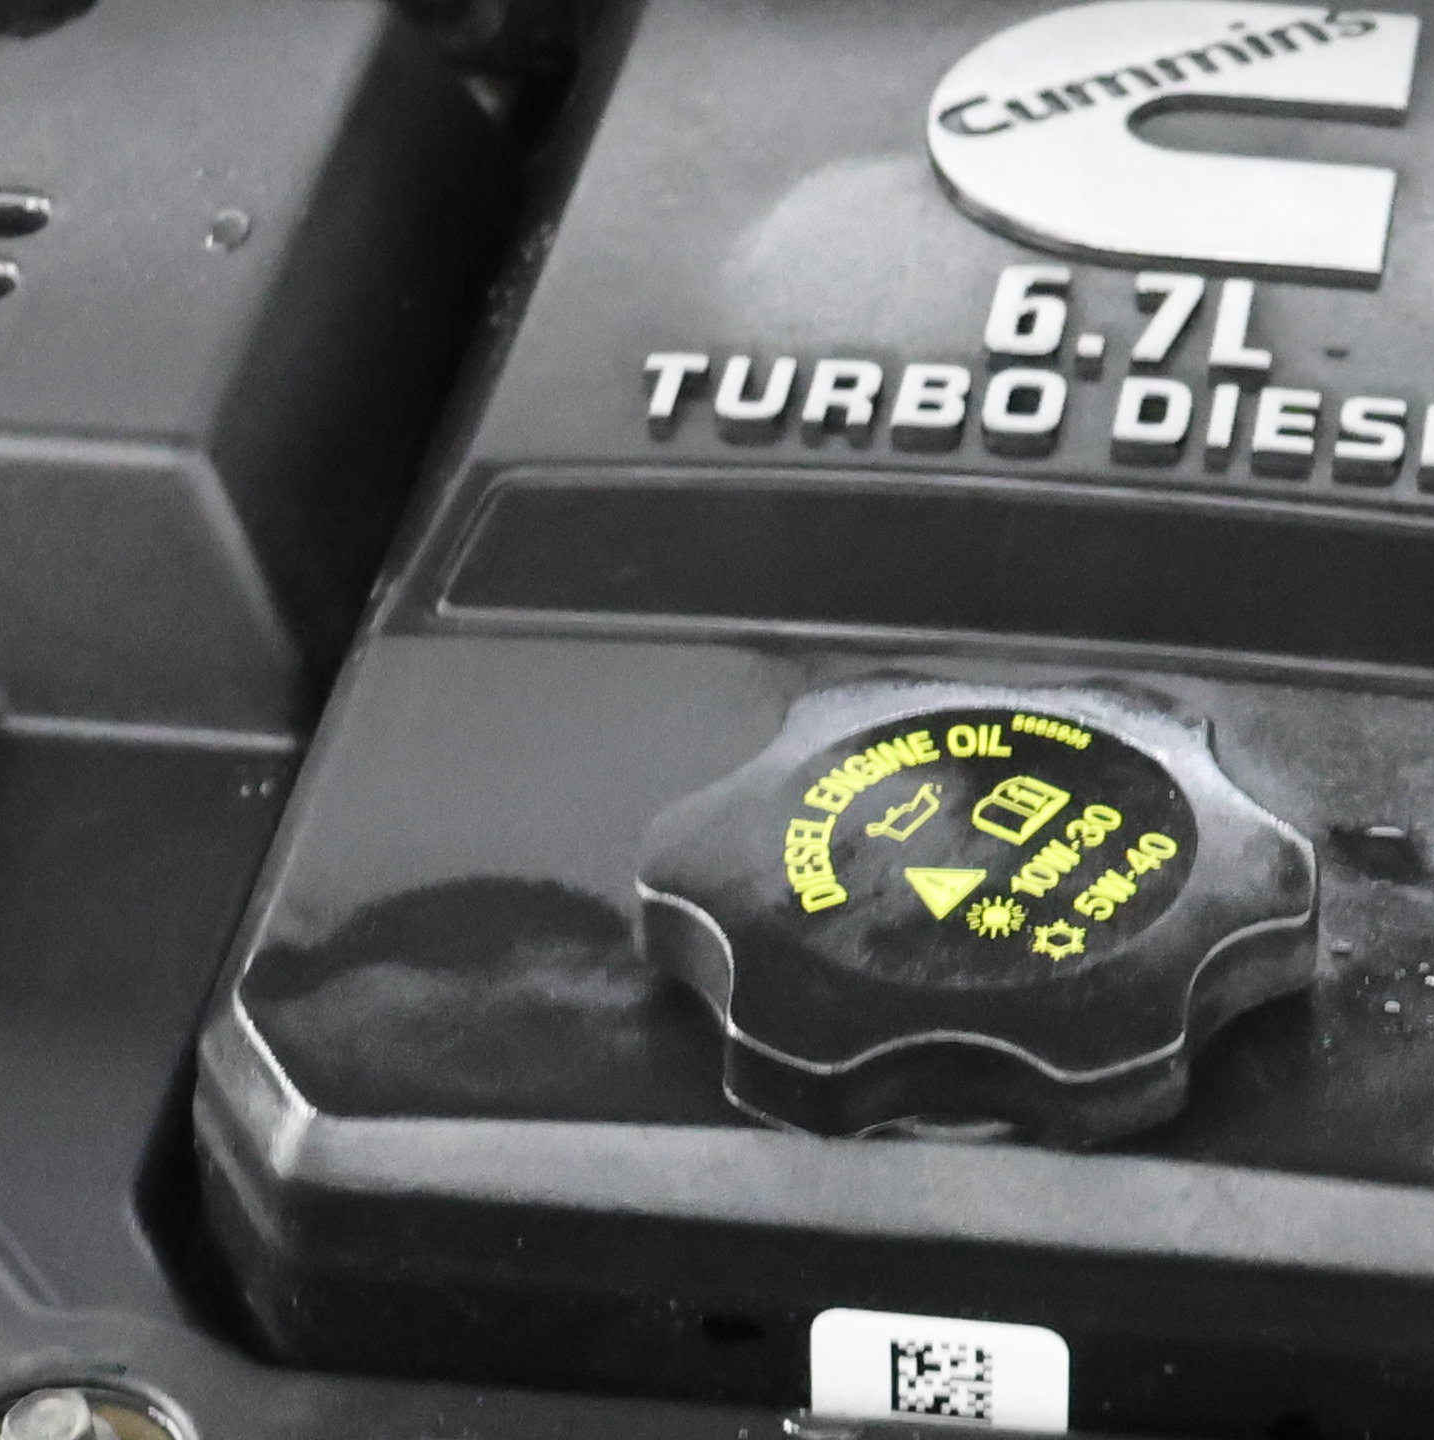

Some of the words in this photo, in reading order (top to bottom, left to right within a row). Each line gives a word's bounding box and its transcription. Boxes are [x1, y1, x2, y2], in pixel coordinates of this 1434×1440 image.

[937, 10, 1378, 137] Cummins
[983, 264, 1272, 370] 6.7L
[643, 351, 1068, 434] TURBO
[804, 729, 942, 815] ENGINE
[946, 723, 1013, 758] OIL
[784, 813, 849, 914] DIESEL
[1010, 803, 1123, 898] 10W-30
[1072, 831, 1178, 922] 5W-40
